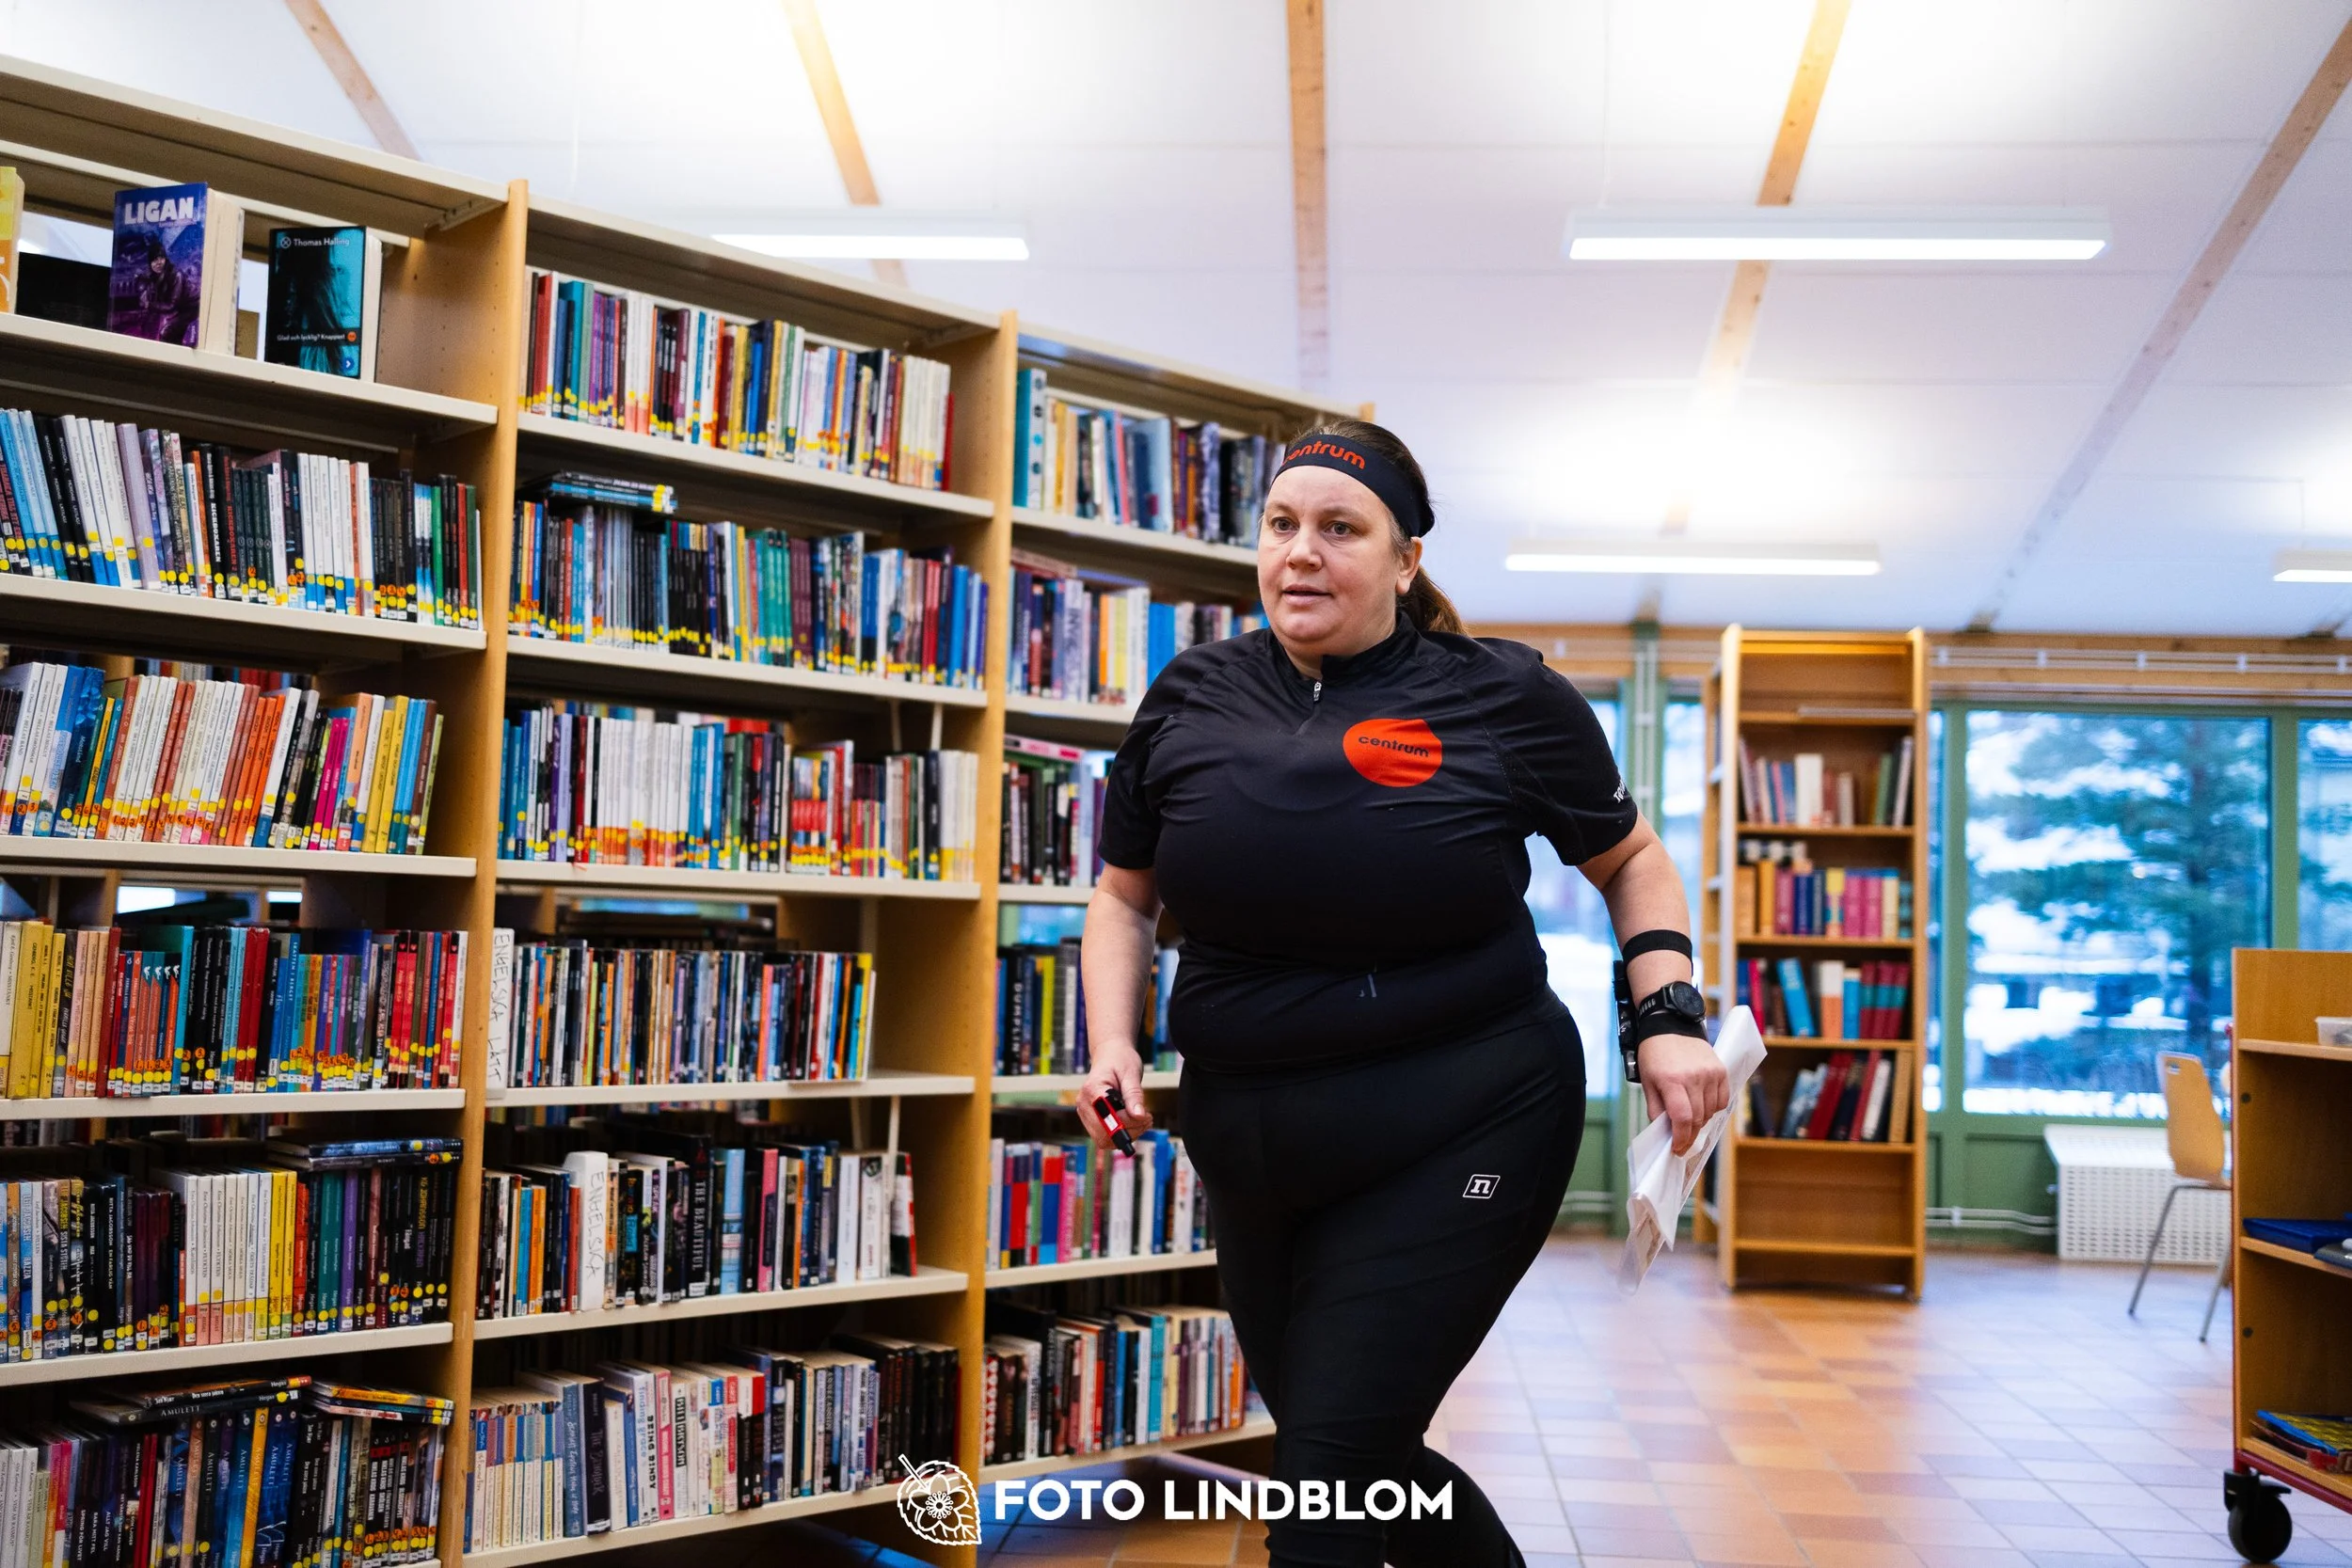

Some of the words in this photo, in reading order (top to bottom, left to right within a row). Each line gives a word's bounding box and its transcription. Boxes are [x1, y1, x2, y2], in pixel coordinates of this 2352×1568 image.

[124, 196, 195, 225] LIGAN
[294, 238, 323, 246] Thomas
[324, 236, 351, 246] Halling
[1282, 440, 1366, 470] entrum
[210, 503, 221, 562] KICKBOXAREN
[227, 506, 236, 564] KICKBOXAREN
[18, 739, 26, 755] BAND
[75, 736, 87, 763] Motstånd
[1358, 734, 1430, 758] centrum
[5, 975, 13, 1006] MISSTÄNKT
[489, 934, 510, 1022] ENGELSKA
[487, 1037, 507, 1083] LÄTT
[418, 1188, 427, 1229] JOHANSSON
[695, 1181, 707, 1204] THE
[23, 1209, 31, 1242] JACOBSEN
[60, 1231, 69, 1247] SISTA
[586, 1172, 605, 1279] ENGELSKA
[691, 1208, 707, 1271] BEAUTIFUL
[24, 1257, 32, 1279] RAZZIA
[59, 1248, 69, 1271] STÖTEN
[161, 1405, 200, 1417] AMULETT
[637, 1387, 646, 1423] finding
[675, 1398, 685, 1423] BILL
[638, 1428, 646, 1458] grace
[675, 1424, 686, 1466] BRYSON
[175, 1457, 184, 1498] AMULETT
[205, 1452, 215, 1493] AMULETT
[238, 1449, 247, 1490] AMULETT
[268, 1446, 278, 1486] AMULETT
[283, 1443, 294, 1482] AMULETT
